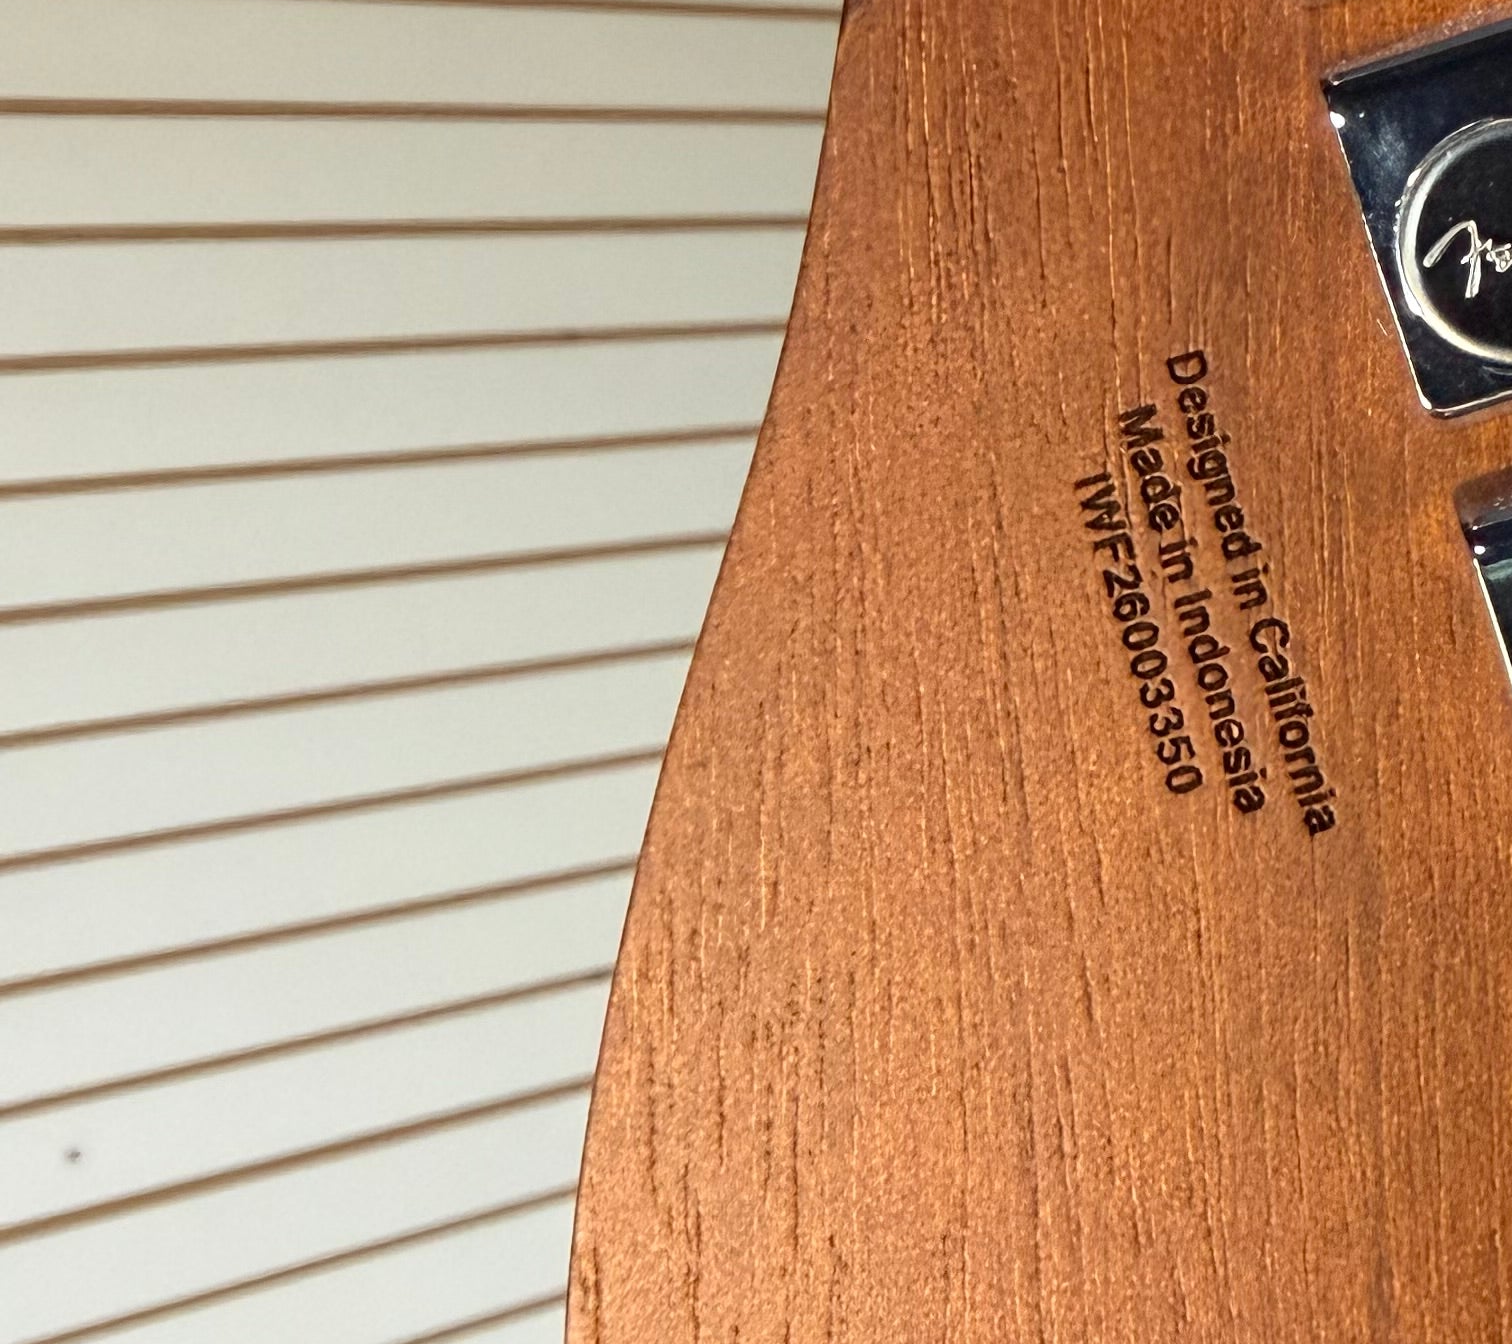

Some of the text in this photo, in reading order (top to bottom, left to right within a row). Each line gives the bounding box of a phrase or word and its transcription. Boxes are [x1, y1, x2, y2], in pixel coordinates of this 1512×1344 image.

[1073, 471, 1202, 795] IWF26003350
[1117, 402, 1267, 815] Made in Indonesia
[1167, 350, 1337, 836] Designed in California
